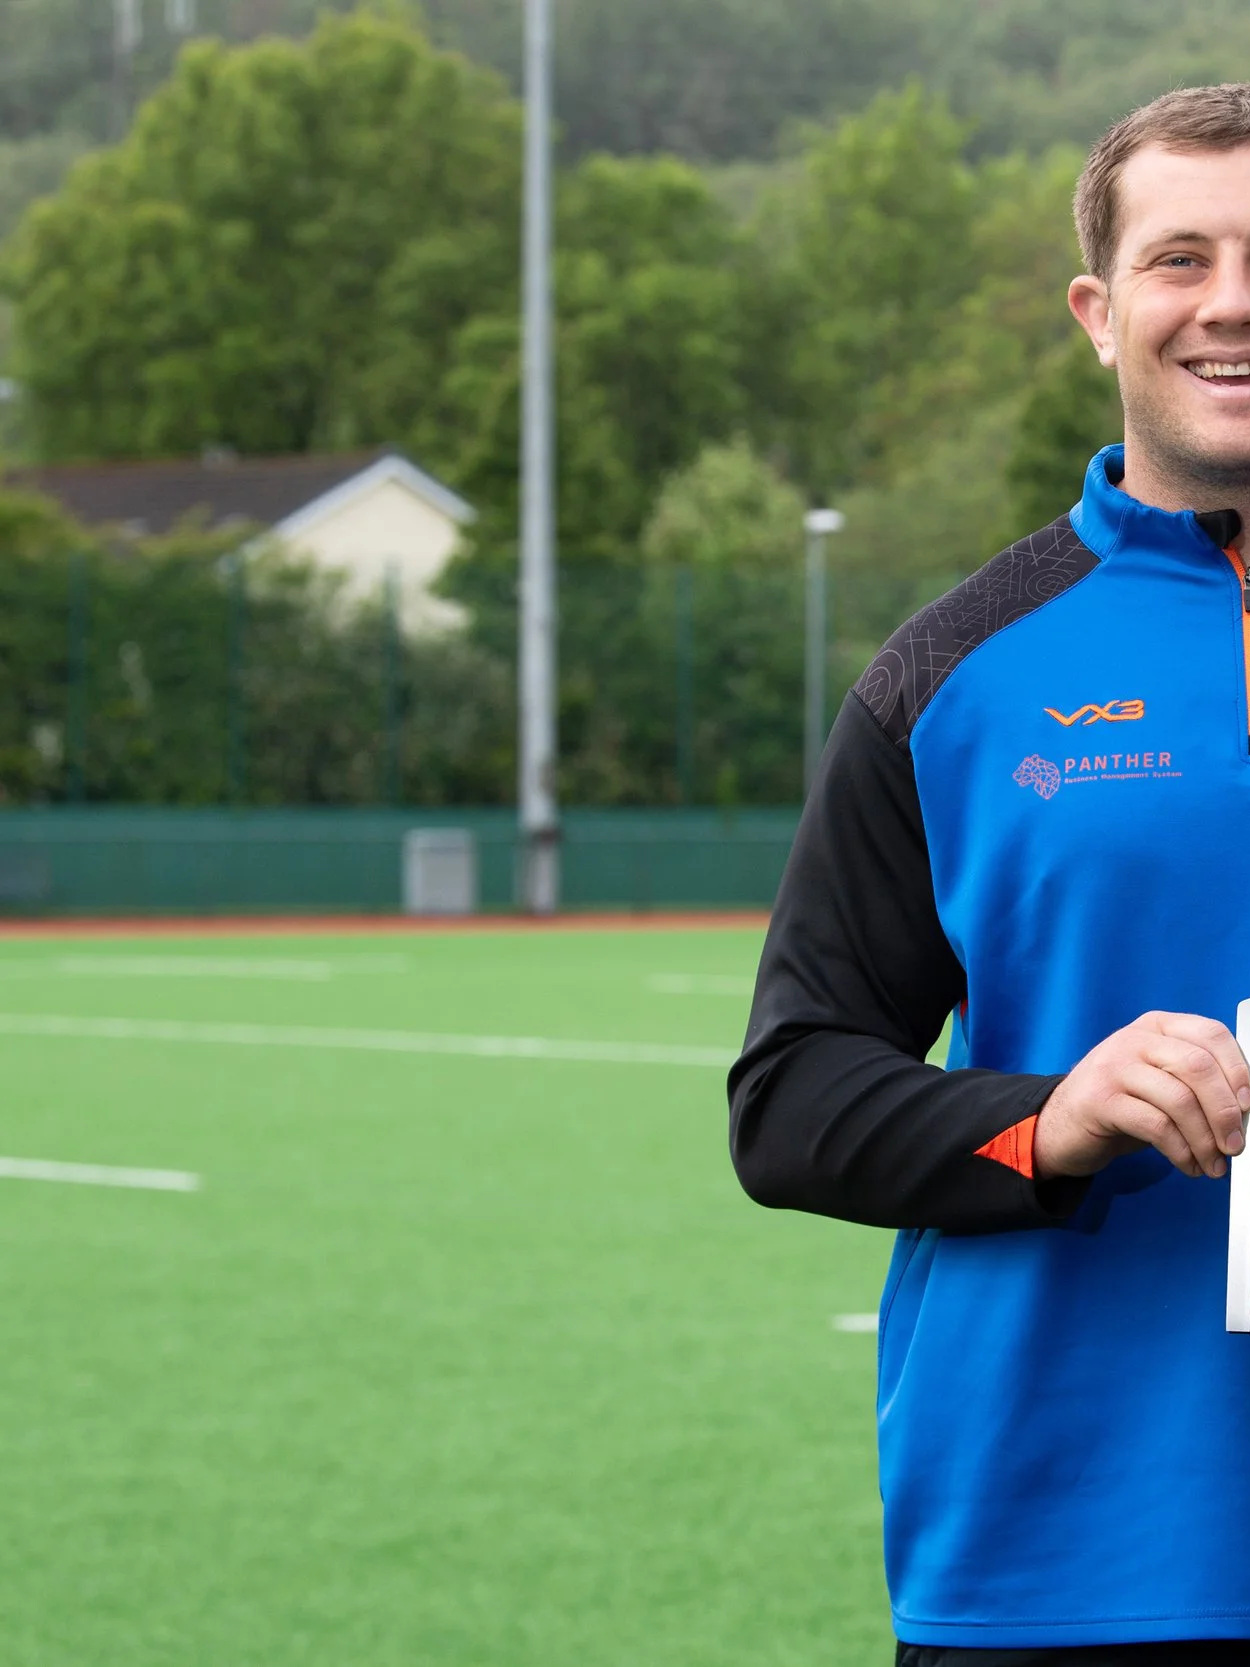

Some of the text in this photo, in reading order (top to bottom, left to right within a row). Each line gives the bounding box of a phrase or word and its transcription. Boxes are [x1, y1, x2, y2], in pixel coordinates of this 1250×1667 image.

[1043, 699, 1145, 727] VX3
[1064, 752, 1171, 774] PANTHER
[1064, 775, 1098, 784] Business
